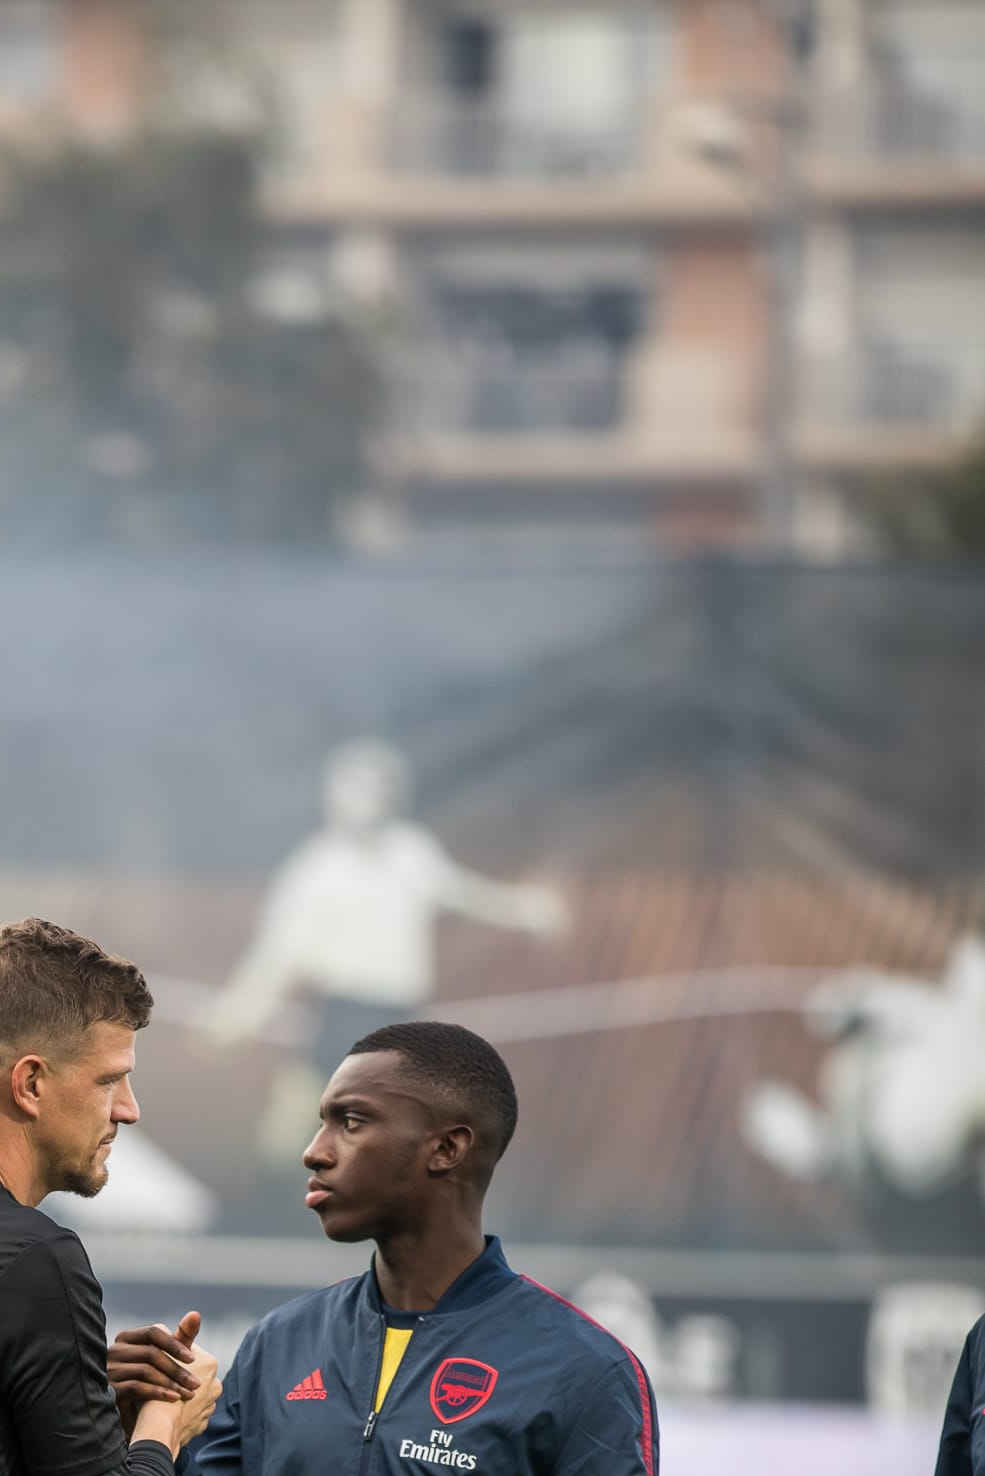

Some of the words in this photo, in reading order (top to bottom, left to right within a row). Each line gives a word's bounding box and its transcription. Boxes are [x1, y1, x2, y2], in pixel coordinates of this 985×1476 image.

[286, 1388, 328, 1400] adidas
[430, 1429, 454, 1446] Fly
[399, 1439, 477, 1470] Emirates
